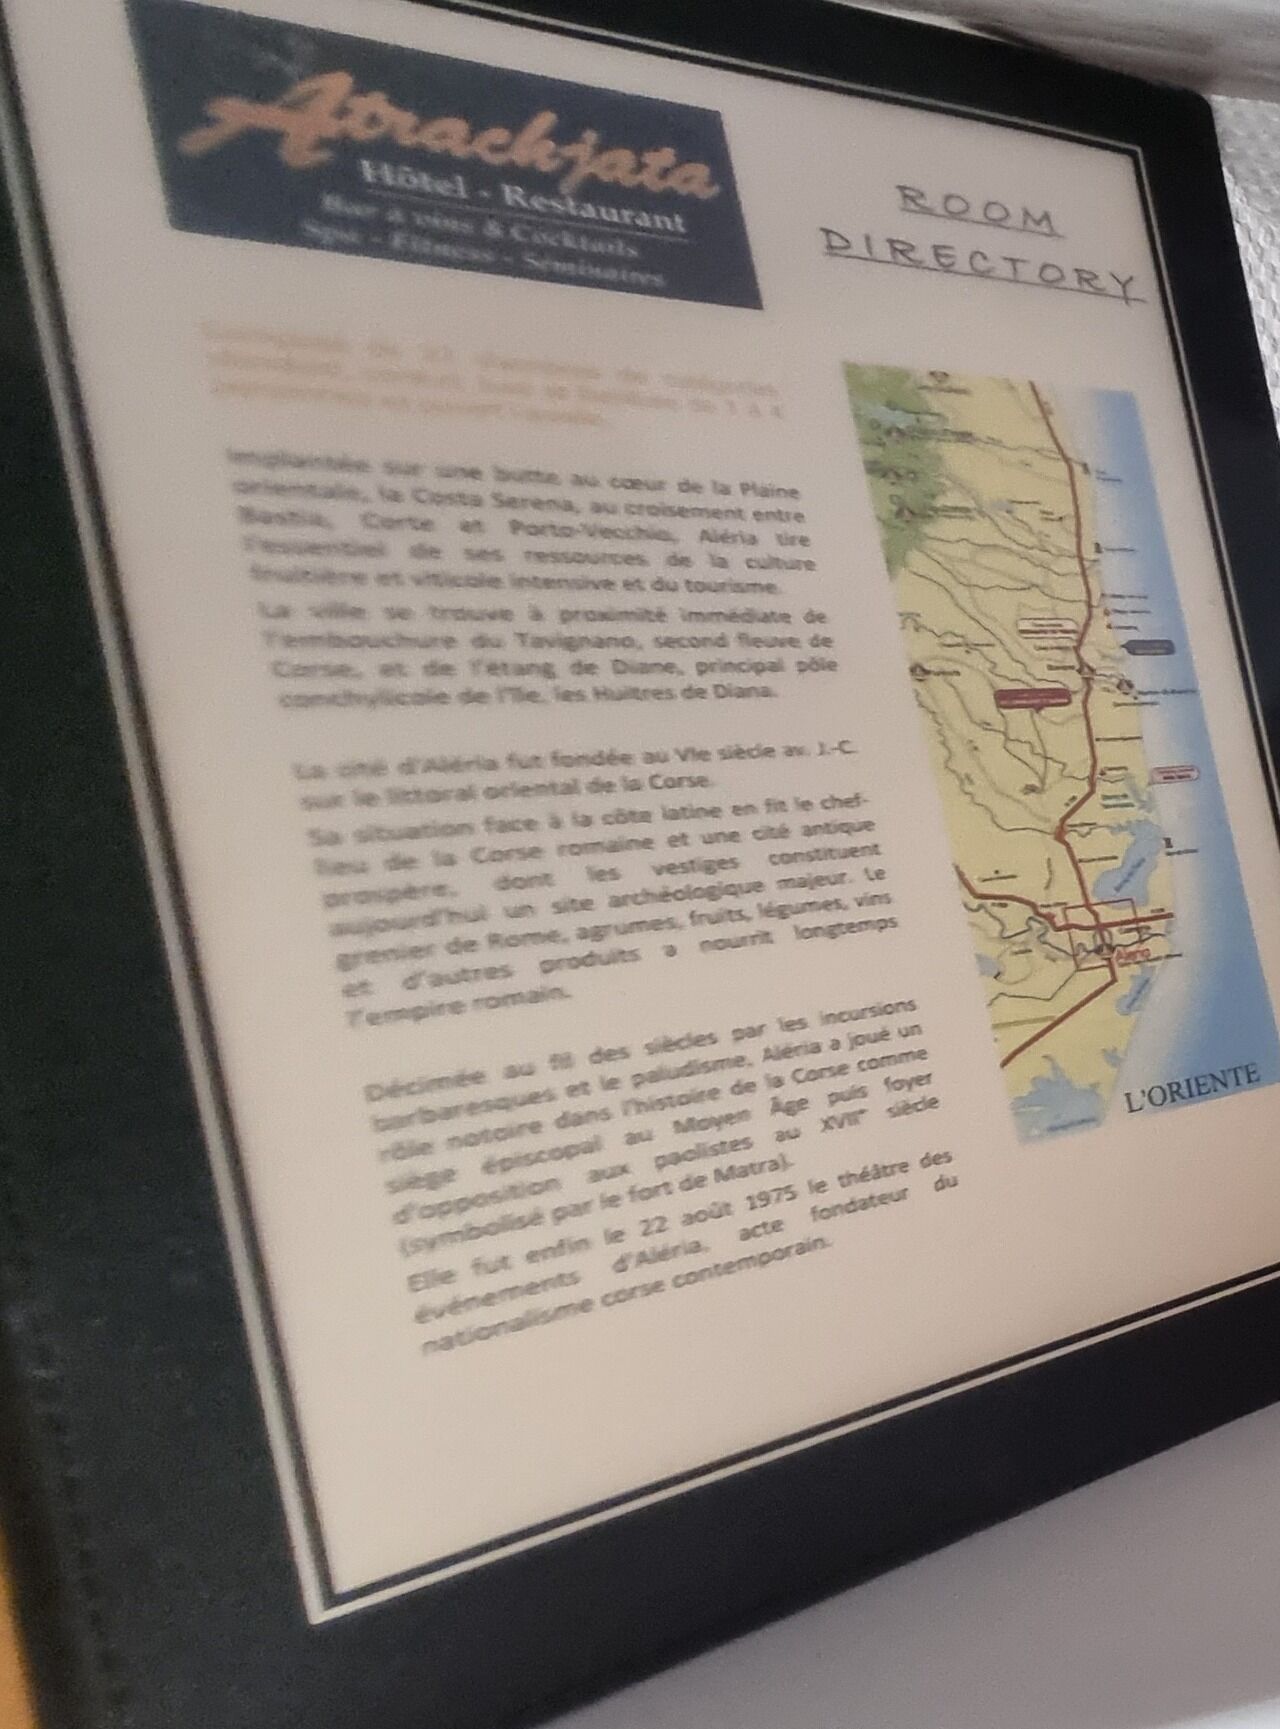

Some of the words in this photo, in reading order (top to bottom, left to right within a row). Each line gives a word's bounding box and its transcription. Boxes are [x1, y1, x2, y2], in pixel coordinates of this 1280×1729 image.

[360, 158, 466, 199] Hôtel
[501, 183, 688, 234] Restaurant
[896, 184, 1056, 233] ROOM
[511, 219, 640, 260] Cocktails
[820, 227, 1136, 304] DIRECTORY
[676, 472, 703, 495] de
[711, 474, 731, 497] la
[738, 476, 800, 500] Plaine
[624, 496, 744, 522] croisement
[751, 502, 805, 525] entre
[698, 522, 758, 546] Aléria
[775, 525, 811, 548] tire
[665, 547, 692, 569] de
[708, 548, 729, 570] la
[744, 549, 816, 572] culture
[621, 571, 644, 593] et
[650, 571, 679, 594] du
[680, 602, 792, 625] immédiate
[803, 603, 827, 625] de
[653, 627, 728, 650] second
[736, 627, 800, 649] fleuve
[808, 627, 834, 649] de
[694, 652, 784, 680] principal
[795, 652, 838, 679] pôle
[680, 679, 707, 701] de
[642, 748, 669, 764] au
[717, 737, 776, 761] siècle
[621, 770, 642, 792] la
[661, 798, 722, 822] latine
[730, 800, 757, 817] en
[763, 792, 787, 815] fit
[793, 791, 813, 813] le
[819, 787, 865, 811] chef-
[666, 826, 689, 849] et
[701, 828, 741, 846] une
[751, 818, 790, 842] cité
[801, 814, 875, 840] antique
[652, 852, 739, 878] vestiges
[768, 835, 881, 867] constituent
[608, 876, 764, 909] archéologique
[863, 862, 886, 884] Le
[854, 886, 892, 909] vins
[663, 942, 677, 958] a
[698, 924, 773, 954] nourrit
[793, 914, 898, 942] longtemps
[644, 1027, 718, 1056] siècles
[731, 1022, 765, 1047] par
[777, 1012, 808, 1034] les
[819, 995, 917, 1027] incursions
[762, 1035, 822, 1064] Aléria
[829, 1036, 841, 1052] a
[847, 1021, 890, 1054] joué
[897, 1022, 922, 1040] un
[729, 1075, 756, 1097] de
[765, 1068, 784, 1090] la
[790, 1061, 849, 1085] Corse
[856, 1046, 928, 1073] comme
[1124, 1063, 1261, 1113] L'ORIENTE
[624, 1127, 653, 1146] au
[672, 1108, 750, 1136] Moyen
[827, 1079, 868, 1110] puis
[883, 1070, 932, 1095] foyer
[653, 1133, 753, 1174] paolistes
[774, 1124, 801, 1143] au
[886, 1089, 940, 1119] siècle
[640, 1210, 667, 1235] 22
[681, 1195, 732, 1226] août
[746, 1179, 797, 1210] 1975
[807, 1174, 827, 1196] le
[836, 1157, 909, 1189] théâtre
[918, 1147, 953, 1169] des
[678, 1170, 707, 1192] de
[738, 1214, 783, 1241] acte
[809, 1186, 908, 1223] fondateur
[933, 1170, 959, 1192] du
